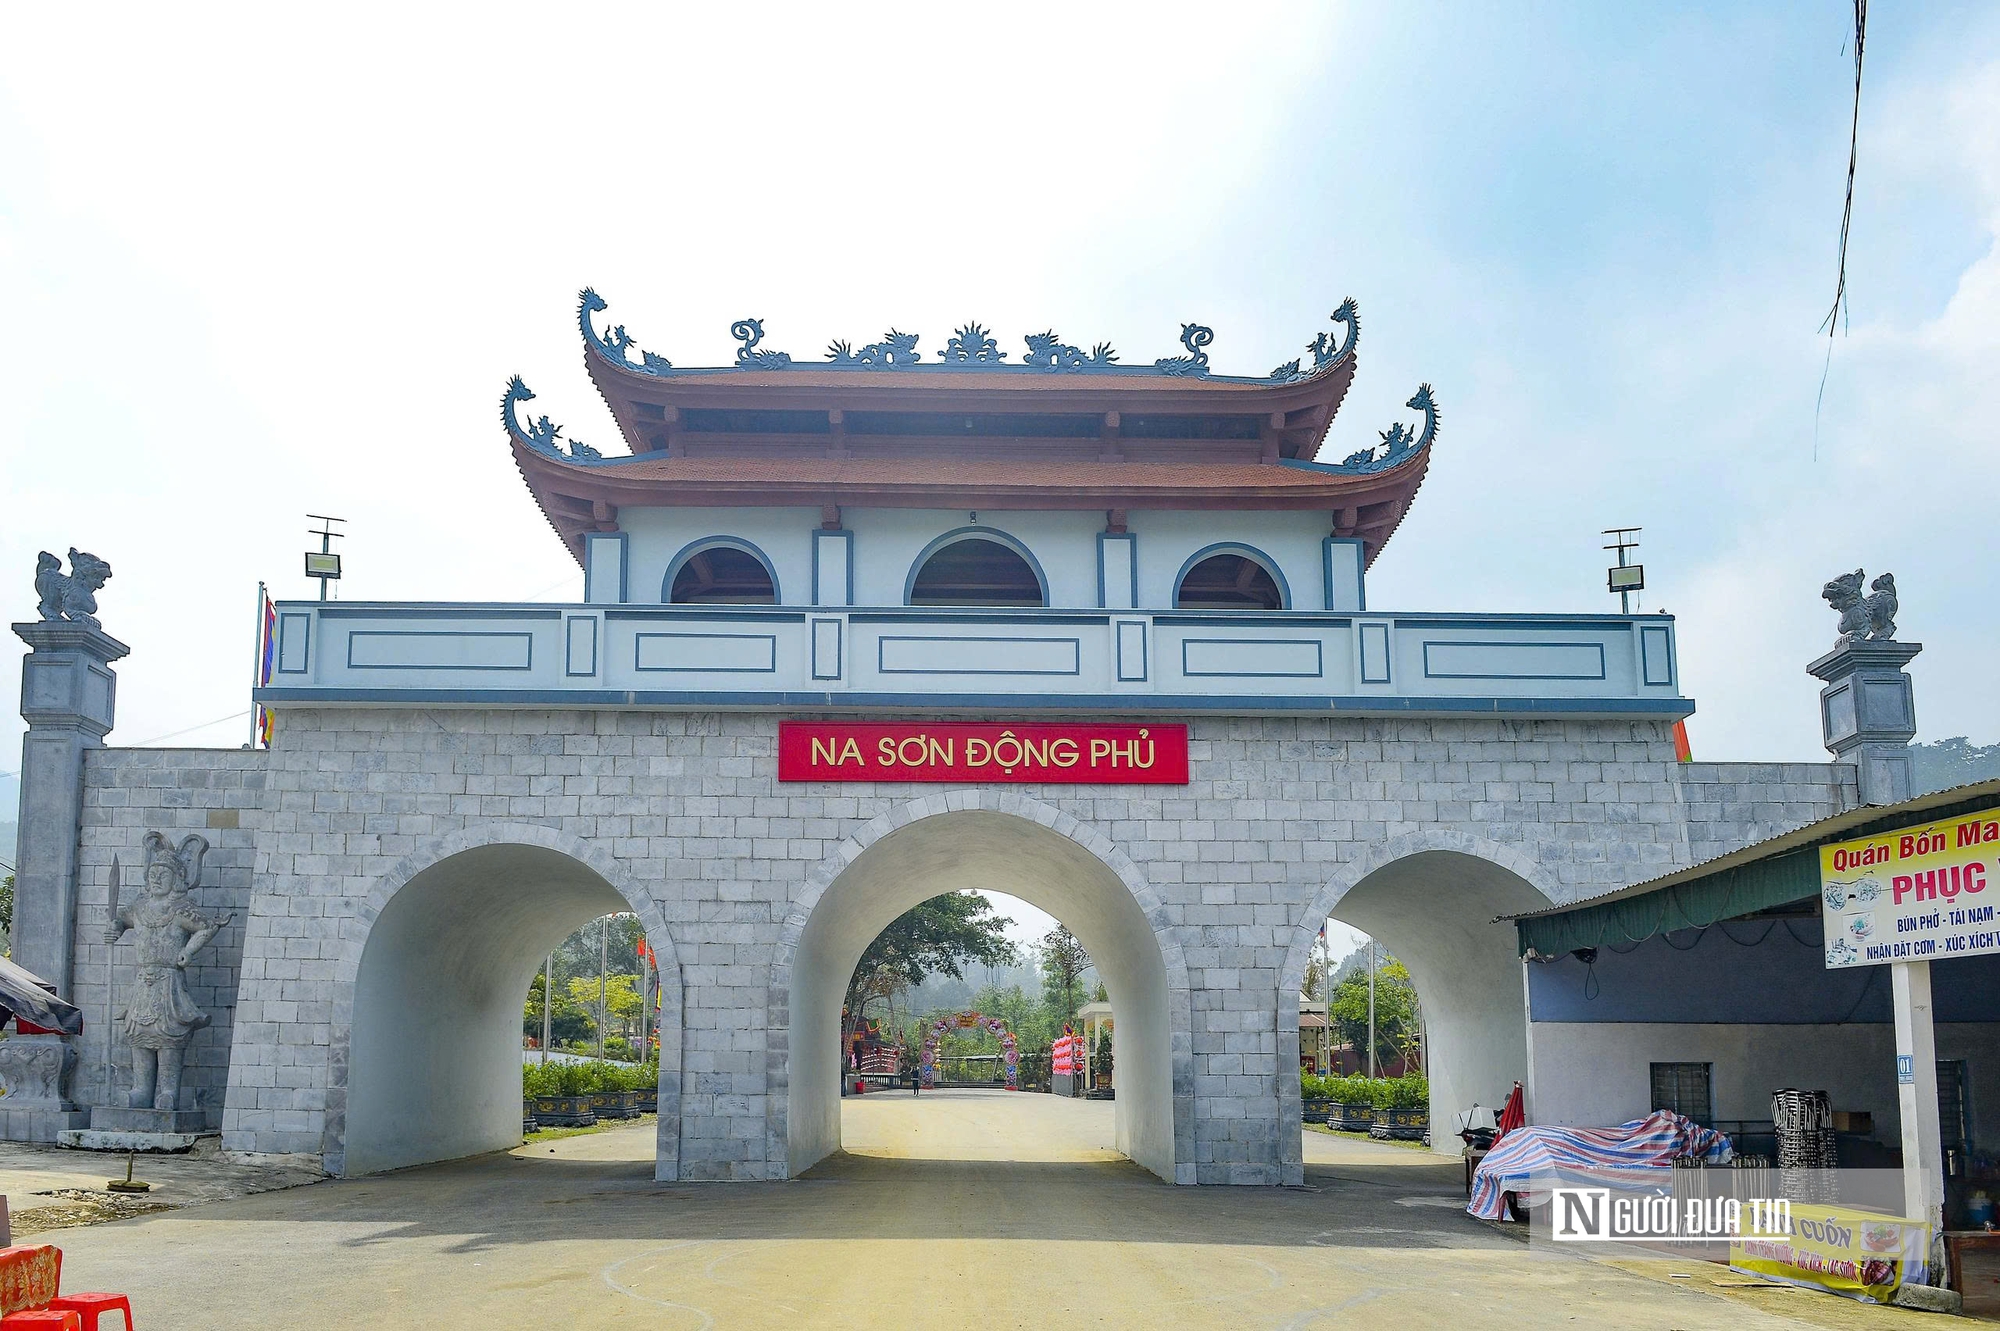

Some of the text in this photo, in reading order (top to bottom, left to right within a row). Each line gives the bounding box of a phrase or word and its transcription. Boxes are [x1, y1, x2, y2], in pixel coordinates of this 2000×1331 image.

[812, 729, 1155, 774] NA SƠN ĐỘNG PHỦ
[1833, 843, 1890, 872] Quán
[1899, 827, 1946, 858] Bốn
[1892, 862, 1986, 905] PHỤC
[1897, 915, 1917, 932] BÚN
[1920, 908, 1940, 930] PHỞ
[1949, 908, 1965, 926] TÁI
[1968, 906, 1994, 925] NẠM
[1866, 942, 1891, 961] NHẬN
[1894, 940, 1911, 959] ĐẶT
[1914, 939, 1936, 955] CƠM
[1945, 934, 1965, 952] XÚC
[1968, 931, 1994, 949] XÍCH
[1900, 1058, 1911, 1073] 01
[1801, 1216, 1852, 1249] CUỐN
